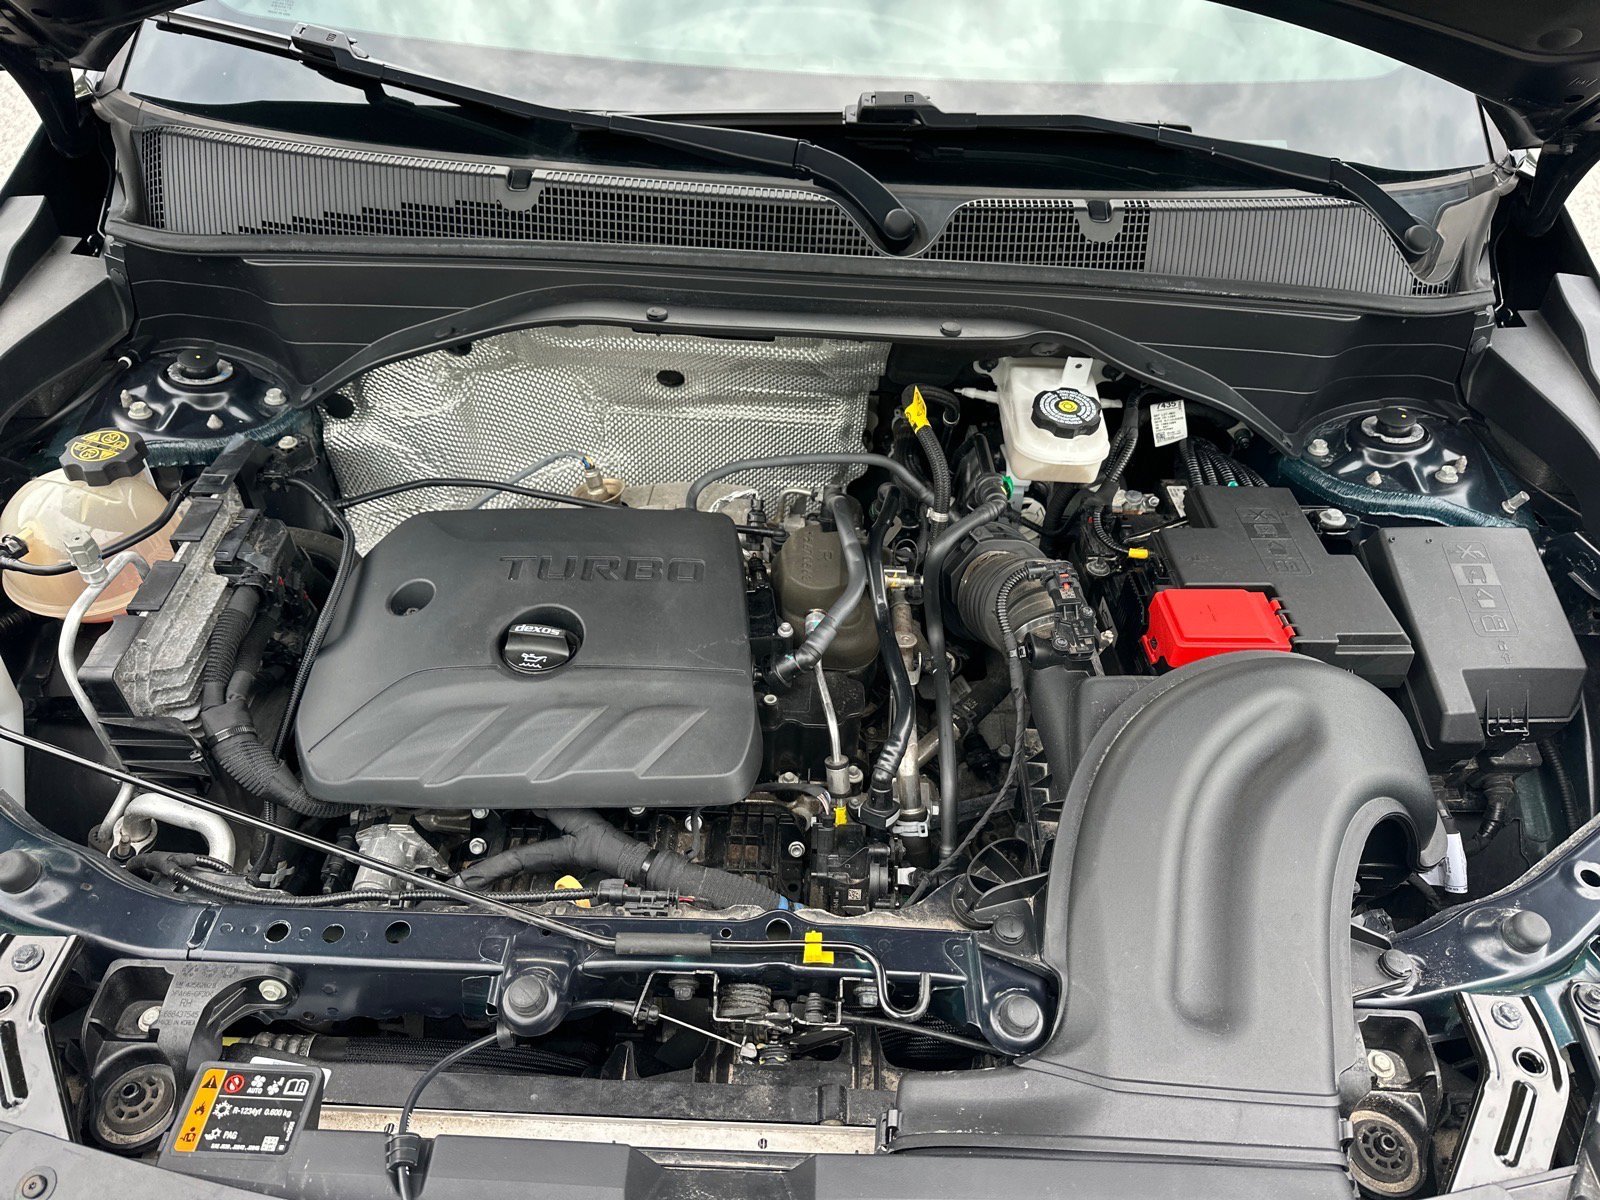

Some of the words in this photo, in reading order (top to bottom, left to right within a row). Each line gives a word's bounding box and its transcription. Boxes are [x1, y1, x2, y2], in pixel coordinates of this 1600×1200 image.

[500, 556, 706, 582] TURBO
[514, 624, 561, 636] dexos
[180, 998, 193, 1007] RH
[246, 1087, 263, 1095] AUTO
[232, 1106, 262, 1118] R-1234yf
[222, 1130, 239, 1140] PAG
